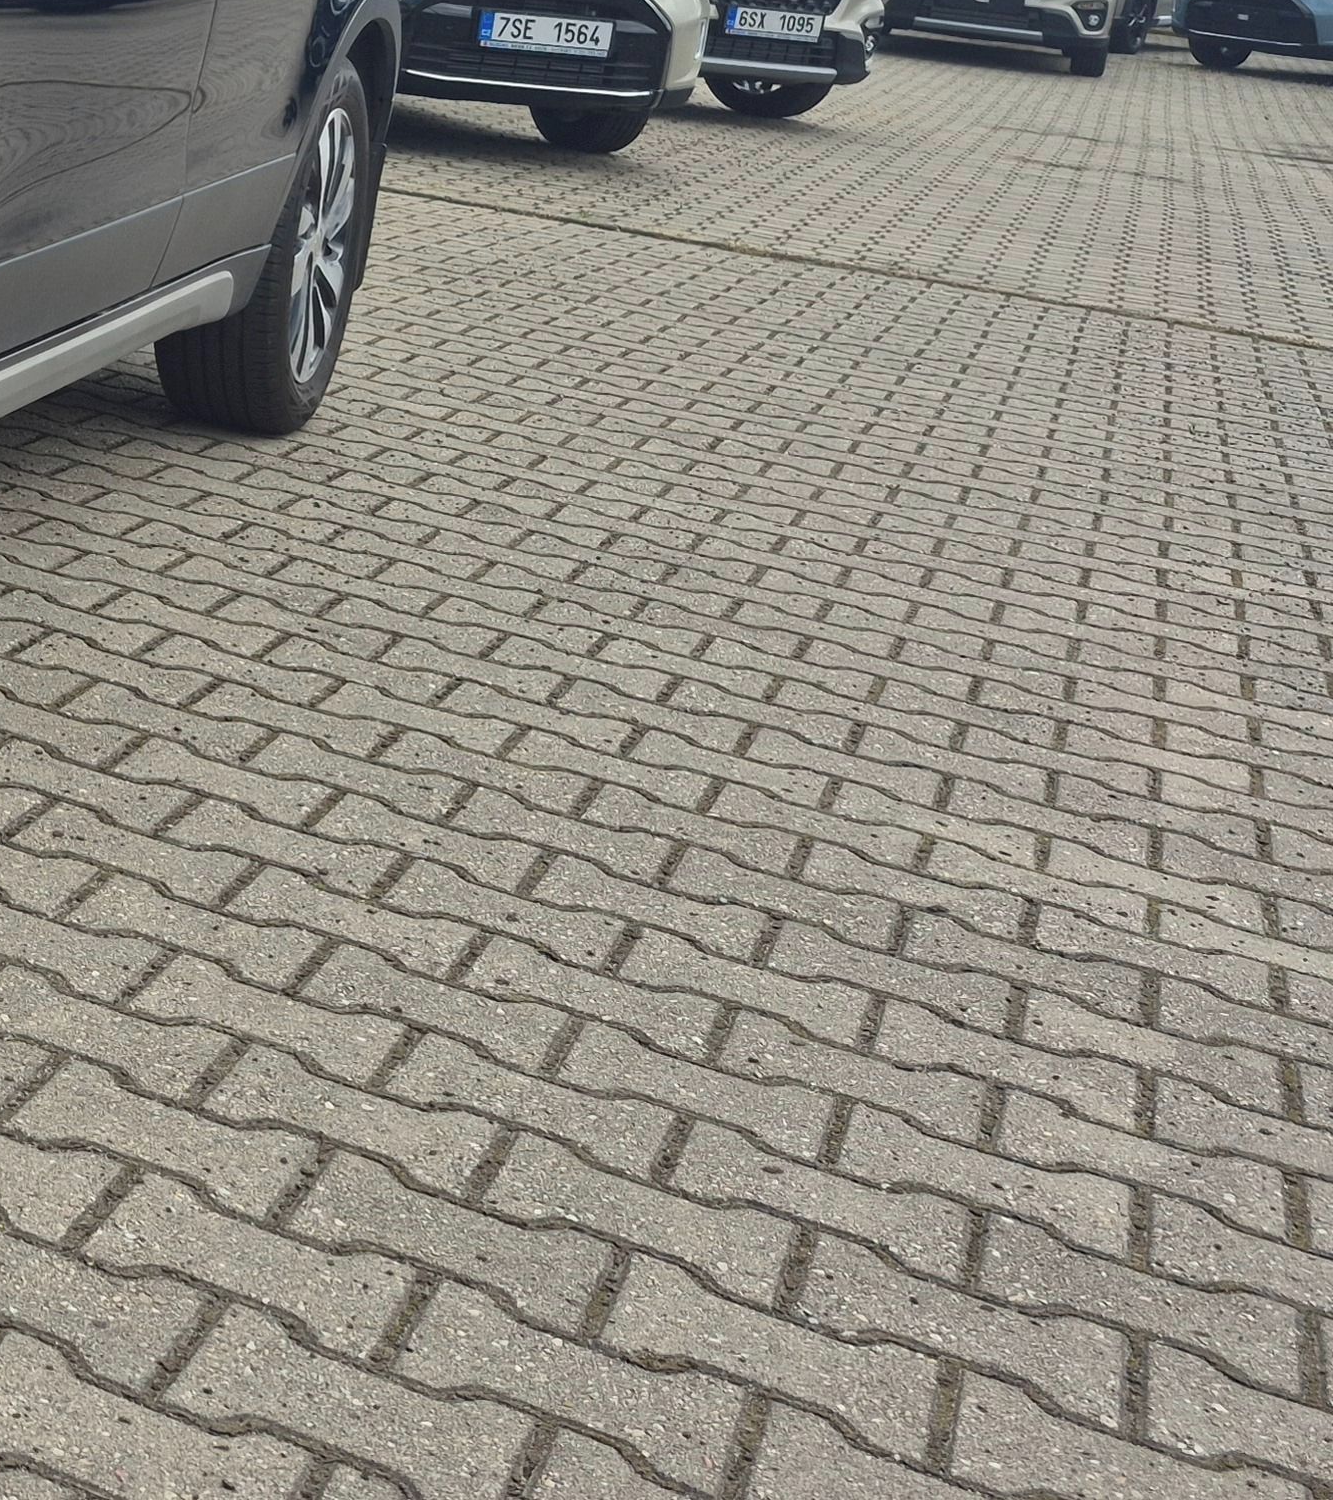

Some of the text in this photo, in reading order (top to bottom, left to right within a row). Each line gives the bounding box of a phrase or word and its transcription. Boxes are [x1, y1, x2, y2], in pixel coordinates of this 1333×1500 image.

[497, 16, 601, 46] 7SE 1564
[738, 10, 767, 29] 6SX
[779, 14, 815, 33] 1095
